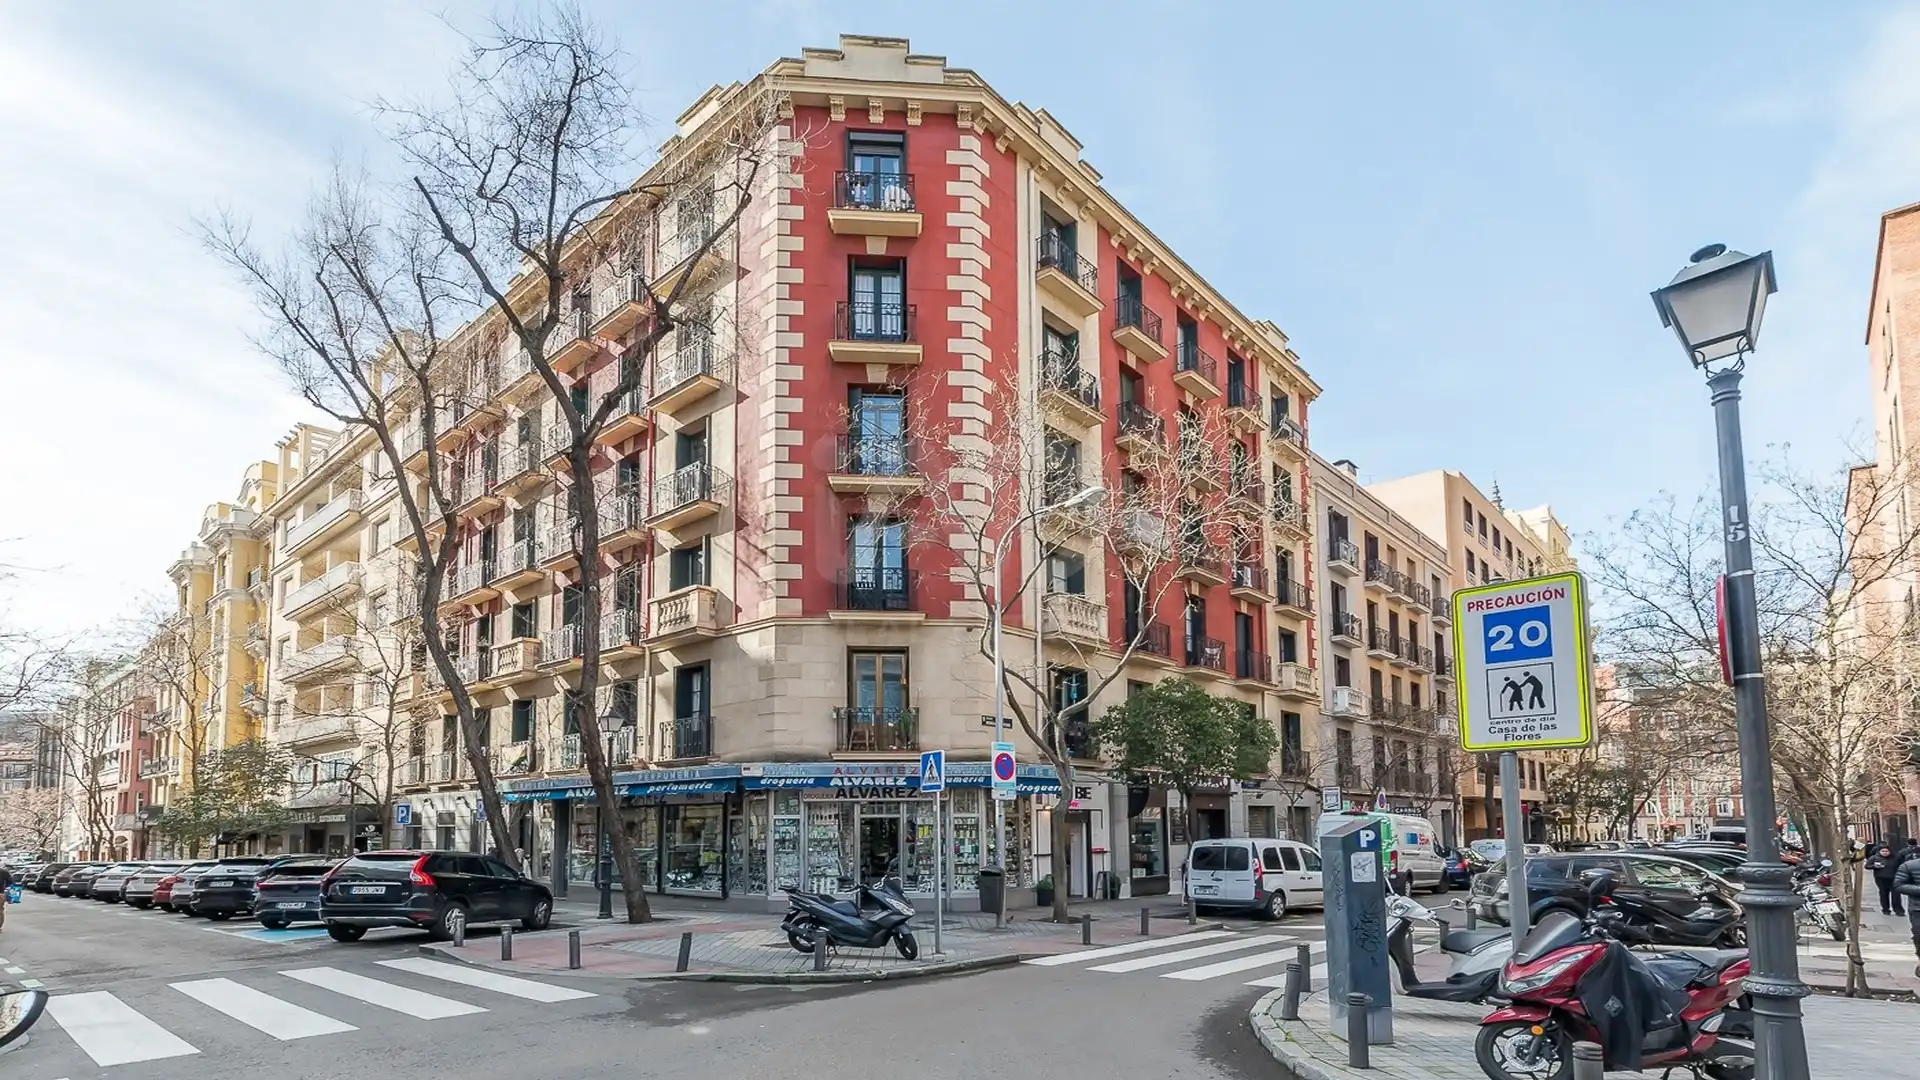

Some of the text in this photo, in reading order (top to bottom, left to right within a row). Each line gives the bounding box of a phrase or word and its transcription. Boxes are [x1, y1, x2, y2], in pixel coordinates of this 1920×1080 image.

[1467, 587, 1565, 612] PRECAUCIÓN
[1488, 620, 1548, 652] 20
[1488, 723, 1557, 734] Casa de las
[1504, 733, 1542, 741] Flores
[833, 766, 918, 775] ALVAREZ
[829, 777, 907, 786] ALVAREZ
[565, 785, 629, 798] ALVAZ
[835, 787, 918, 798] ALVAREZ
[1360, 830, 1376, 848] P
